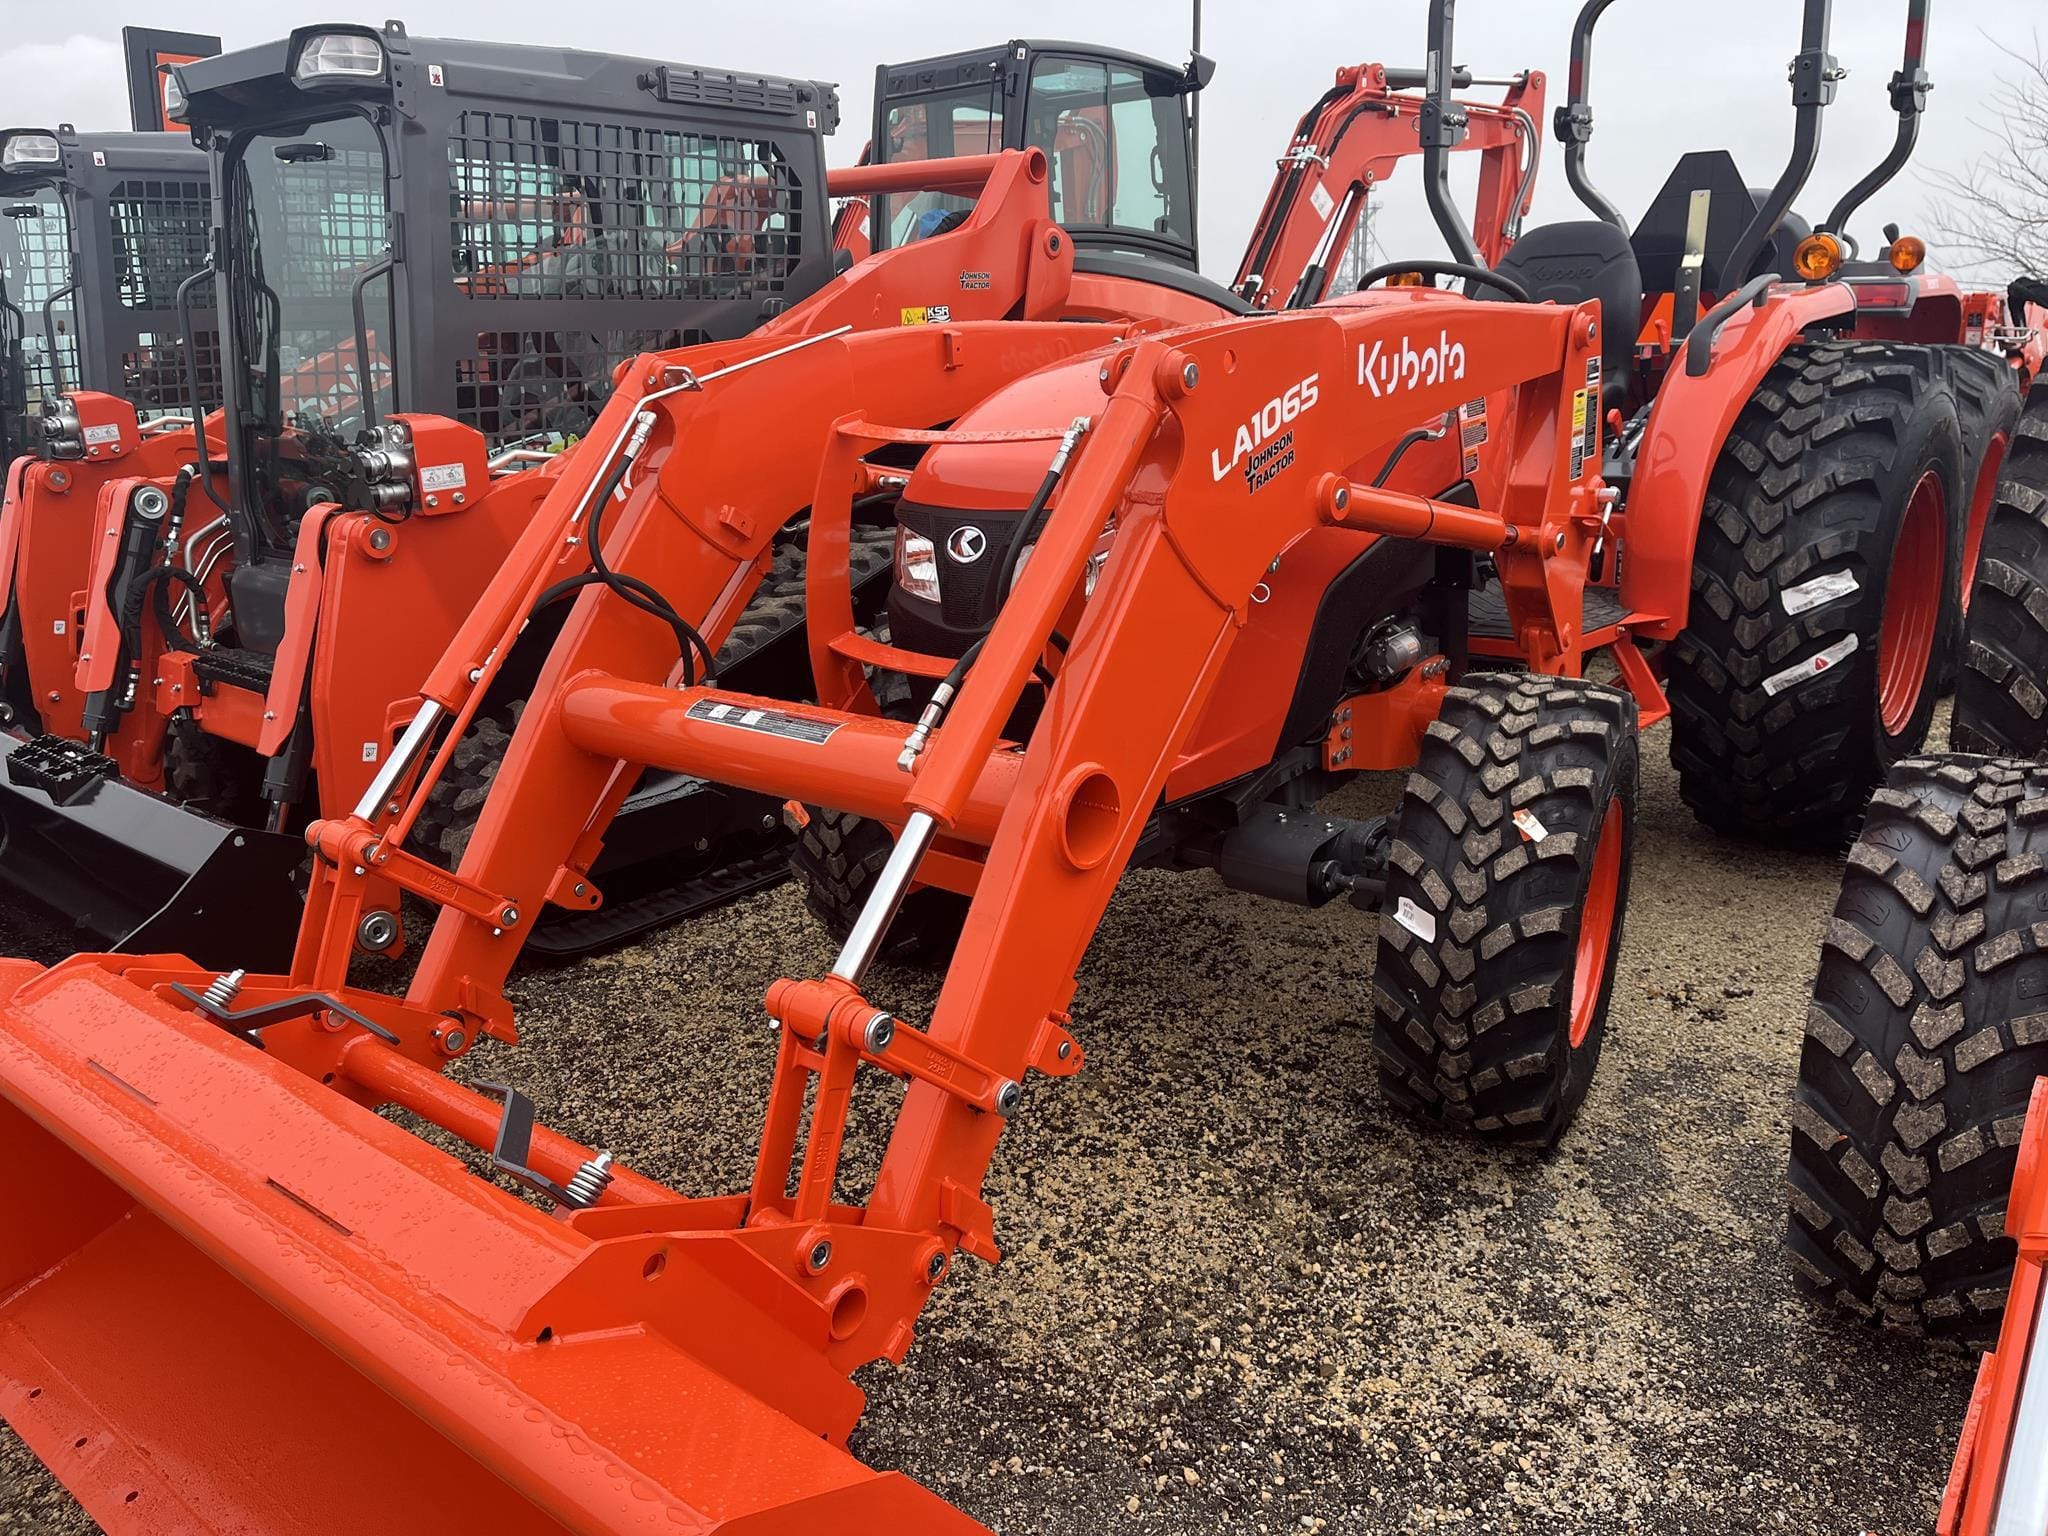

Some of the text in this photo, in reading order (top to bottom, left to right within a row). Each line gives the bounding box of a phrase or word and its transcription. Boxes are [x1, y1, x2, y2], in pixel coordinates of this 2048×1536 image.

[960, 270, 990, 279] JOHNSON
[960, 280, 990, 289] TRACTOR
[927, 305, 950, 317] KSR
[1358, 329, 1465, 398] Kubota
[1212, 372, 1319, 482] LA1065
[1245, 431, 1293, 476] JOHNSON
[1247, 450, 1294, 494] TRACTOR
